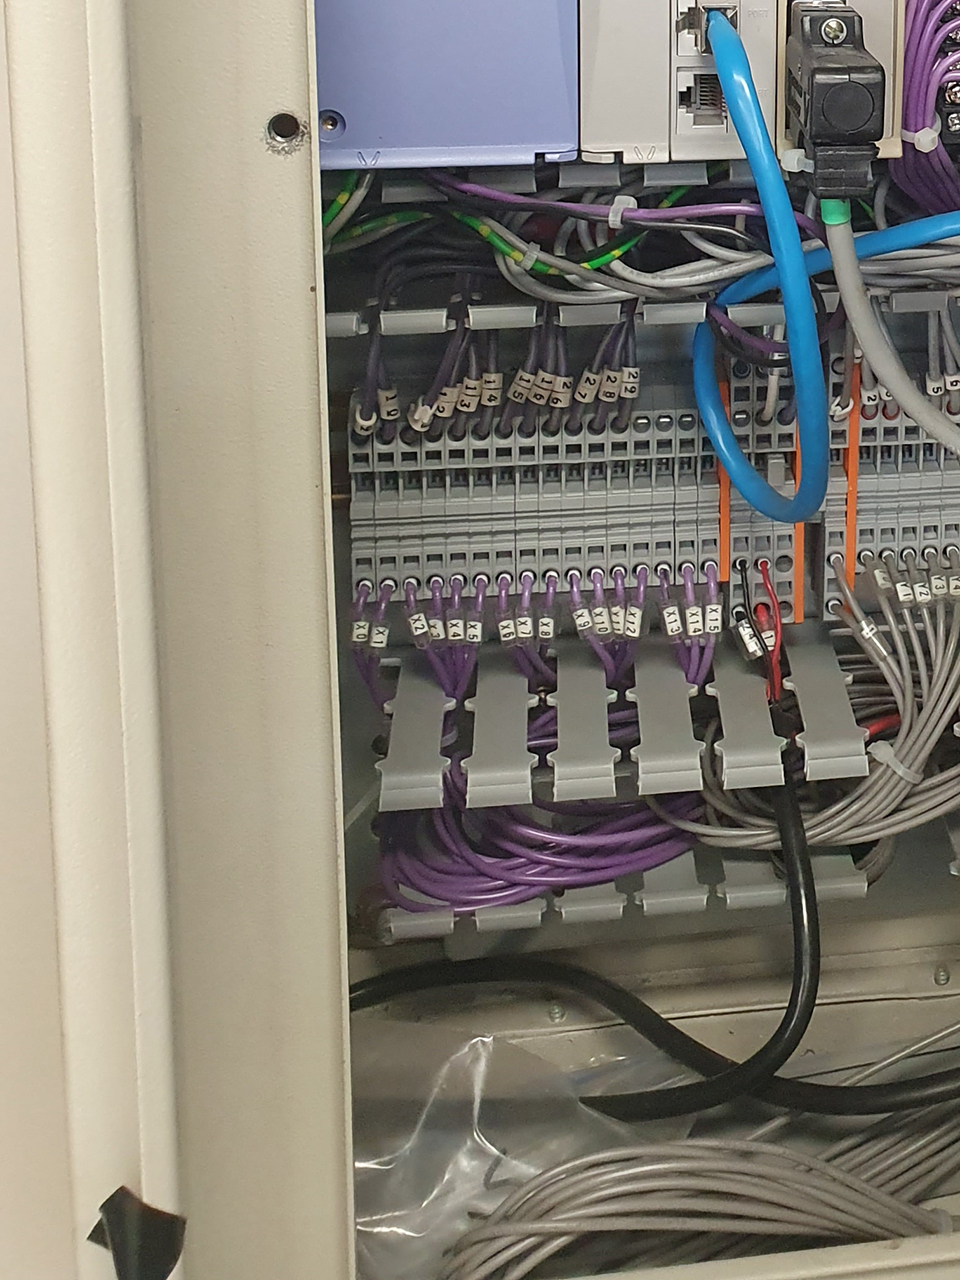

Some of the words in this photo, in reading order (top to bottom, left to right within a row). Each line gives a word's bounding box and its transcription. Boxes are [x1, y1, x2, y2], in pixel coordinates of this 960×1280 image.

[484, 379, 498, 403] 14
[512, 375, 531, 399] 15
[533, 377, 553, 401] 16
[577, 376, 596, 399] 27
[603, 375, 617, 398] 28
[624, 371, 638, 394] 29
[932, 386, 942, 394] 5
[460, 385, 477, 409] 13
[551, 382, 572, 405] 26
[867, 394, 877, 402] 2
[900, 583, 912, 597] Y1
[918, 583, 929, 597] Y2
[934, 575, 945, 590] Y3
[410, 615, 426, 632] X2
[517, 620, 531, 636] X7
[575, 612, 590, 628] X9
[593, 611, 609, 633] X10
[626, 611, 638, 634] X12
[666, 610, 681, 633] X13
[689, 611, 702, 633] X14
[708, 607, 720, 632] X15
[356, 624, 367, 639] X0
[375, 629, 385, 644] X1
[430, 623, 441, 638] X3
[449, 622, 461, 638] X4
[468, 623, 478, 640] X5
[500, 624, 515, 638] X6
[540, 621, 551, 636] X8
